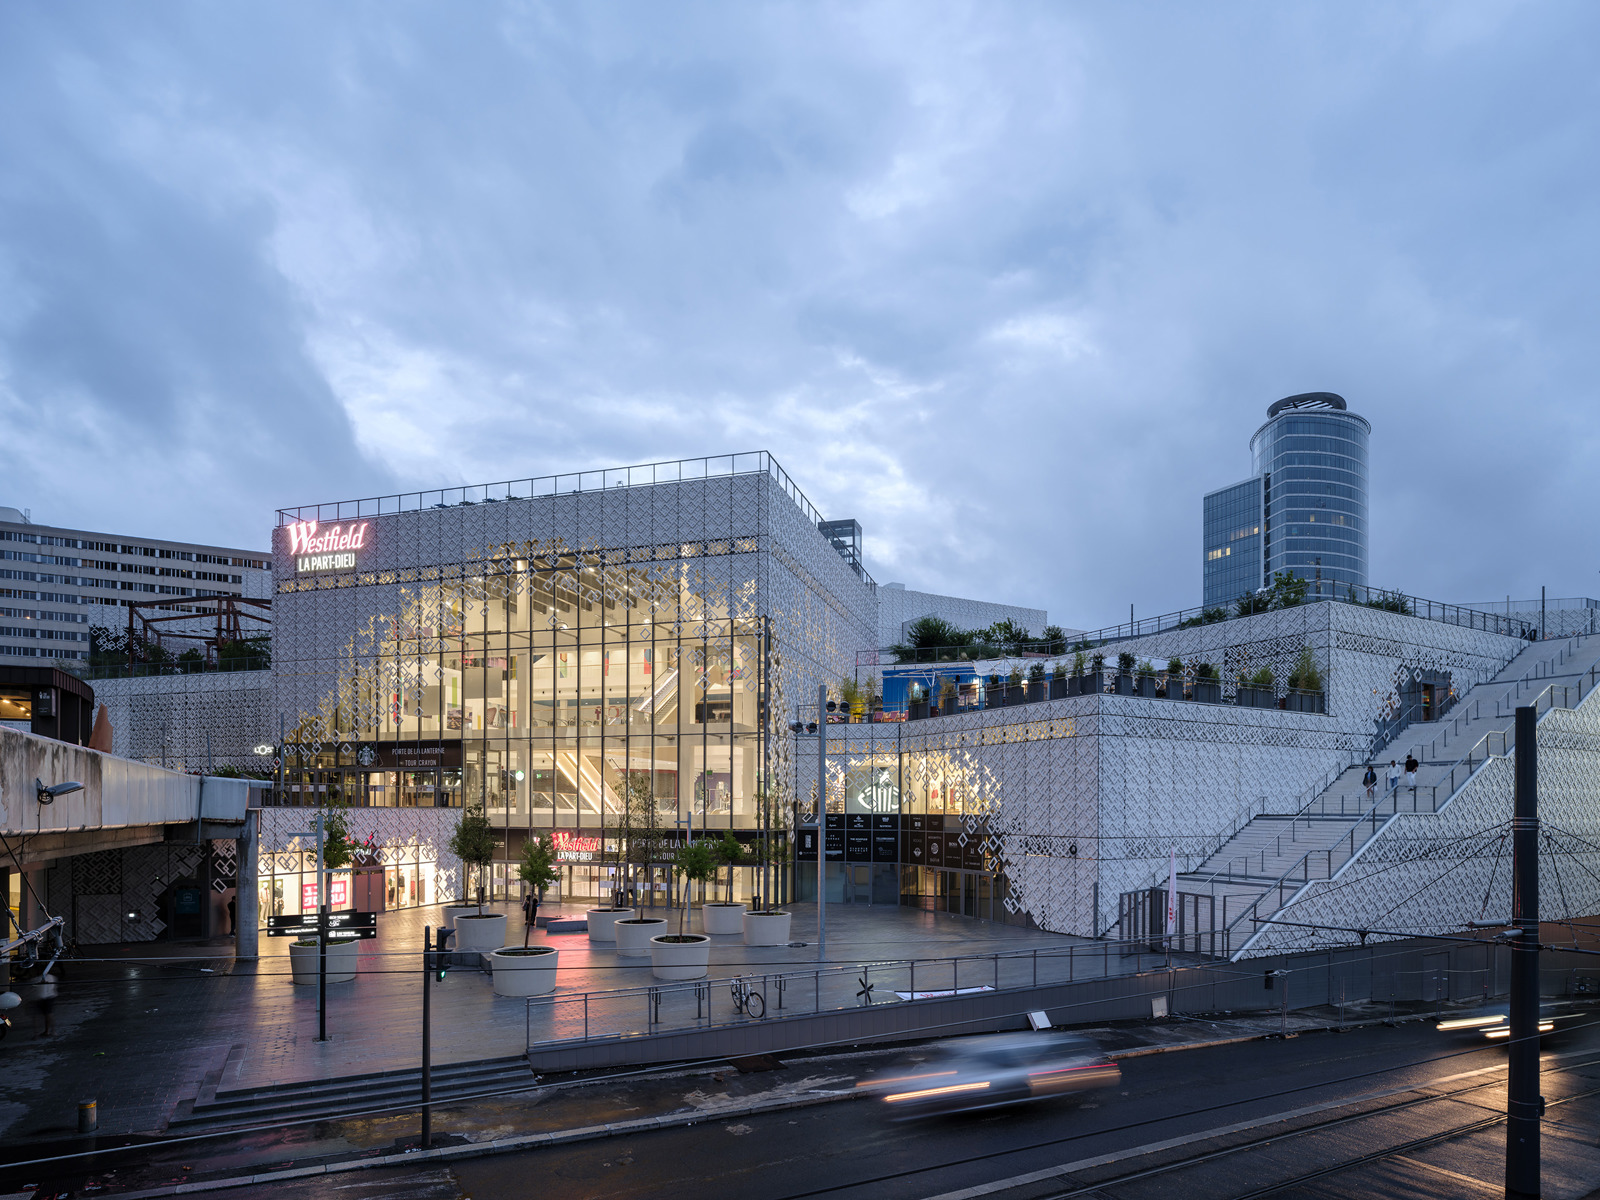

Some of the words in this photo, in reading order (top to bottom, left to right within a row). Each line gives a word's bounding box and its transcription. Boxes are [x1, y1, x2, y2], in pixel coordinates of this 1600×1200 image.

[287, 520, 368, 555] Westfield
[299, 557, 310, 572] LA
[311, 553, 355, 571] PART-DIEU
[550, 832, 600, 851] Westfield
[669, 839, 681, 849] LA
[557, 851, 565, 860] LA
[565, 852, 593, 860] PART-DIEU
